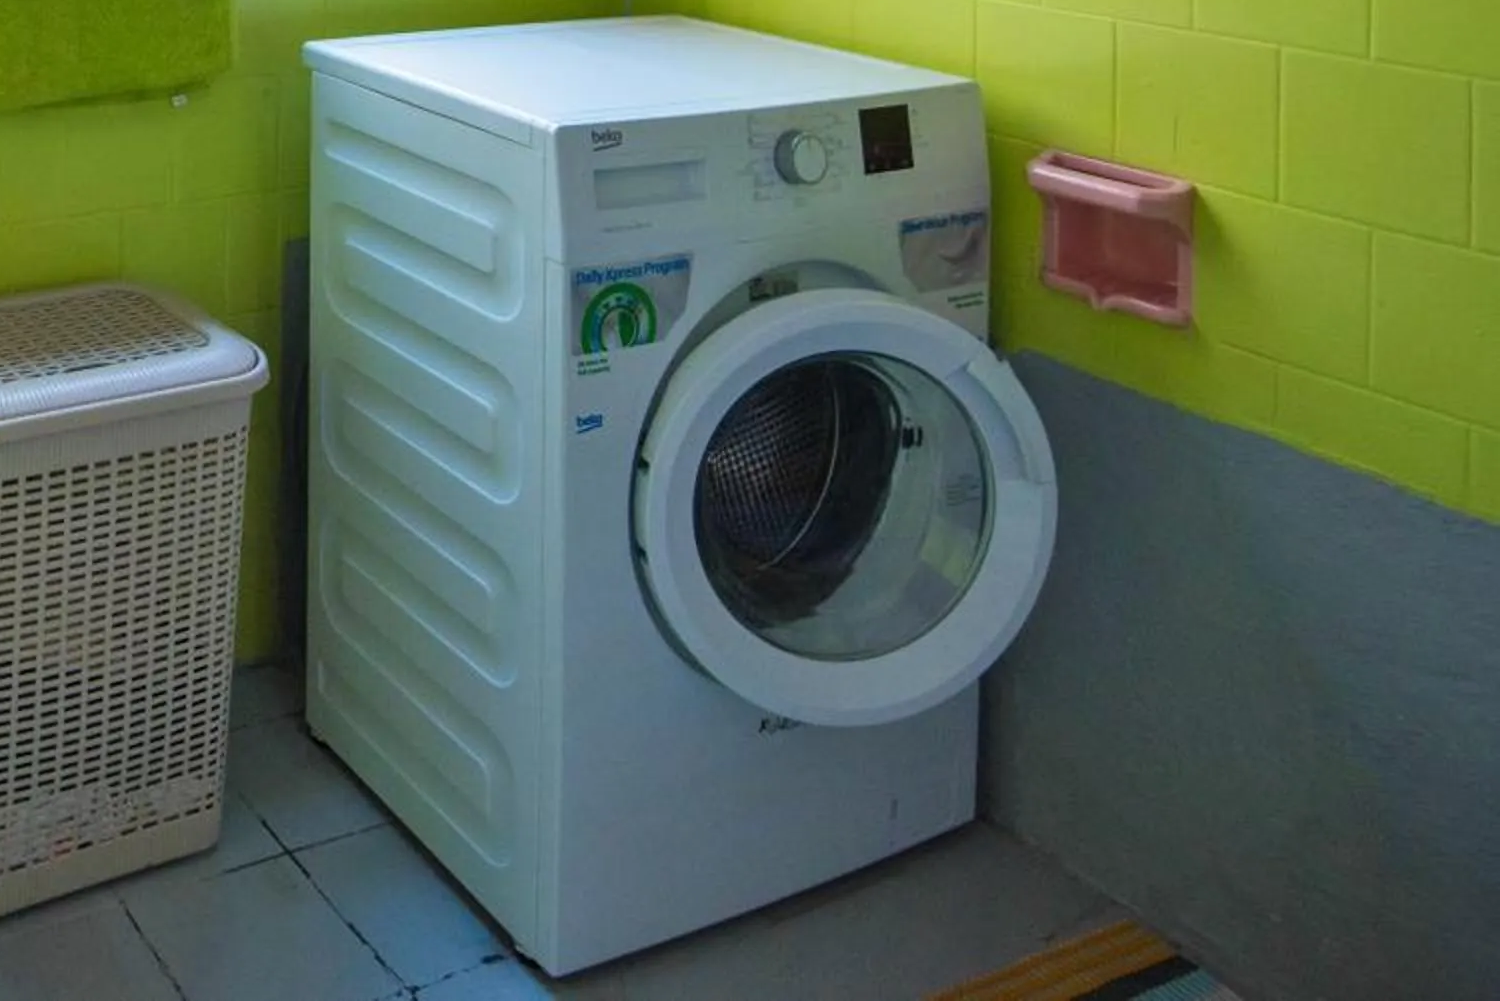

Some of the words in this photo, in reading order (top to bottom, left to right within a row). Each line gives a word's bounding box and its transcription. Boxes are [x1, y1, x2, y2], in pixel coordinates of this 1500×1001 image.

[591, 129, 623, 148] beko
[576, 267, 603, 286] Daily
[644, 256, 690, 276] Program
